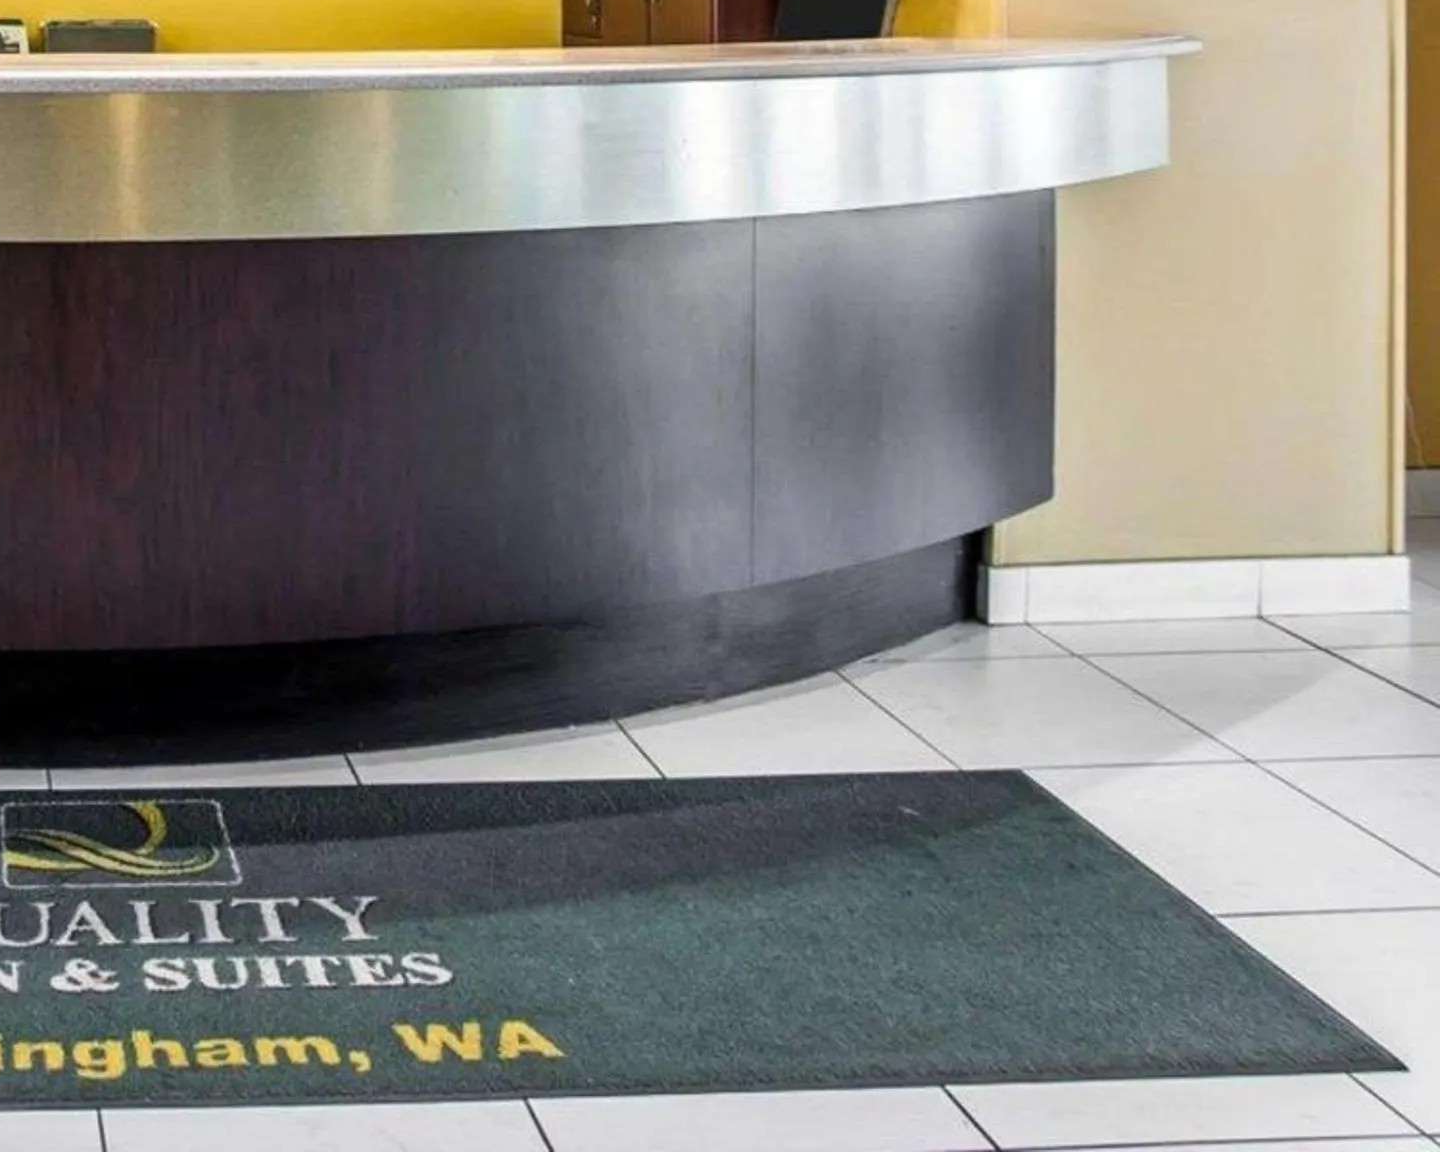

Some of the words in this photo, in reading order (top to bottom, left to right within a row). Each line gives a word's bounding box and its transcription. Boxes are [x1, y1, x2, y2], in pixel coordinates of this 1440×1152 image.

[50, 957, 121, 993] &
[141, 951, 454, 992] SUITES
[392, 1020, 568, 1064] WA
